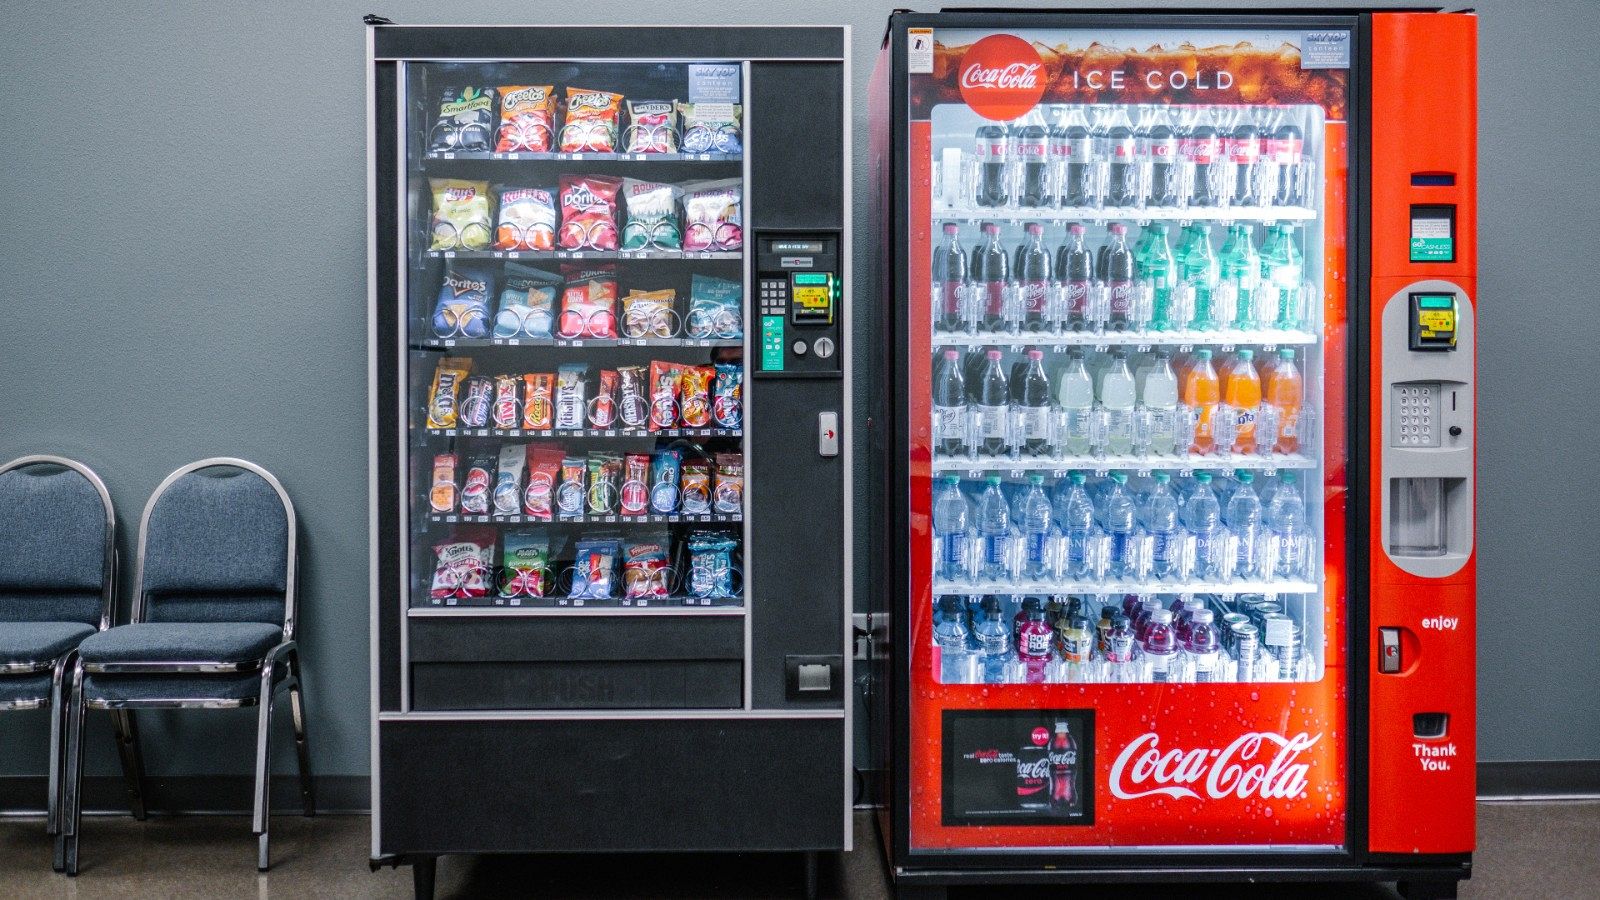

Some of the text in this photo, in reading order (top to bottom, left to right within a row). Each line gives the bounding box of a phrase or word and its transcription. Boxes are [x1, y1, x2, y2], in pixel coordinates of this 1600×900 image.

[1307, 33, 1347, 41] SKY TOP
[695, 68, 736, 77] SKY TOP
[962, 63, 1041, 89] Coca-Cola
[1074, 70, 1234, 89] ICE COLD
[443, 99, 489, 113] Smartfood
[505, 88, 545, 110] Cheetos
[569, 92, 611, 112] Cheetos
[502, 189, 549, 203] RUFFLES
[442, 276, 487, 292] Doritos
[1422, 615, 1458, 630] enjoy
[1412, 743, 1457, 757] Thank
[1108, 732, 1323, 801] Coca-Cola
[1420, 759, 1450, 771] You.
